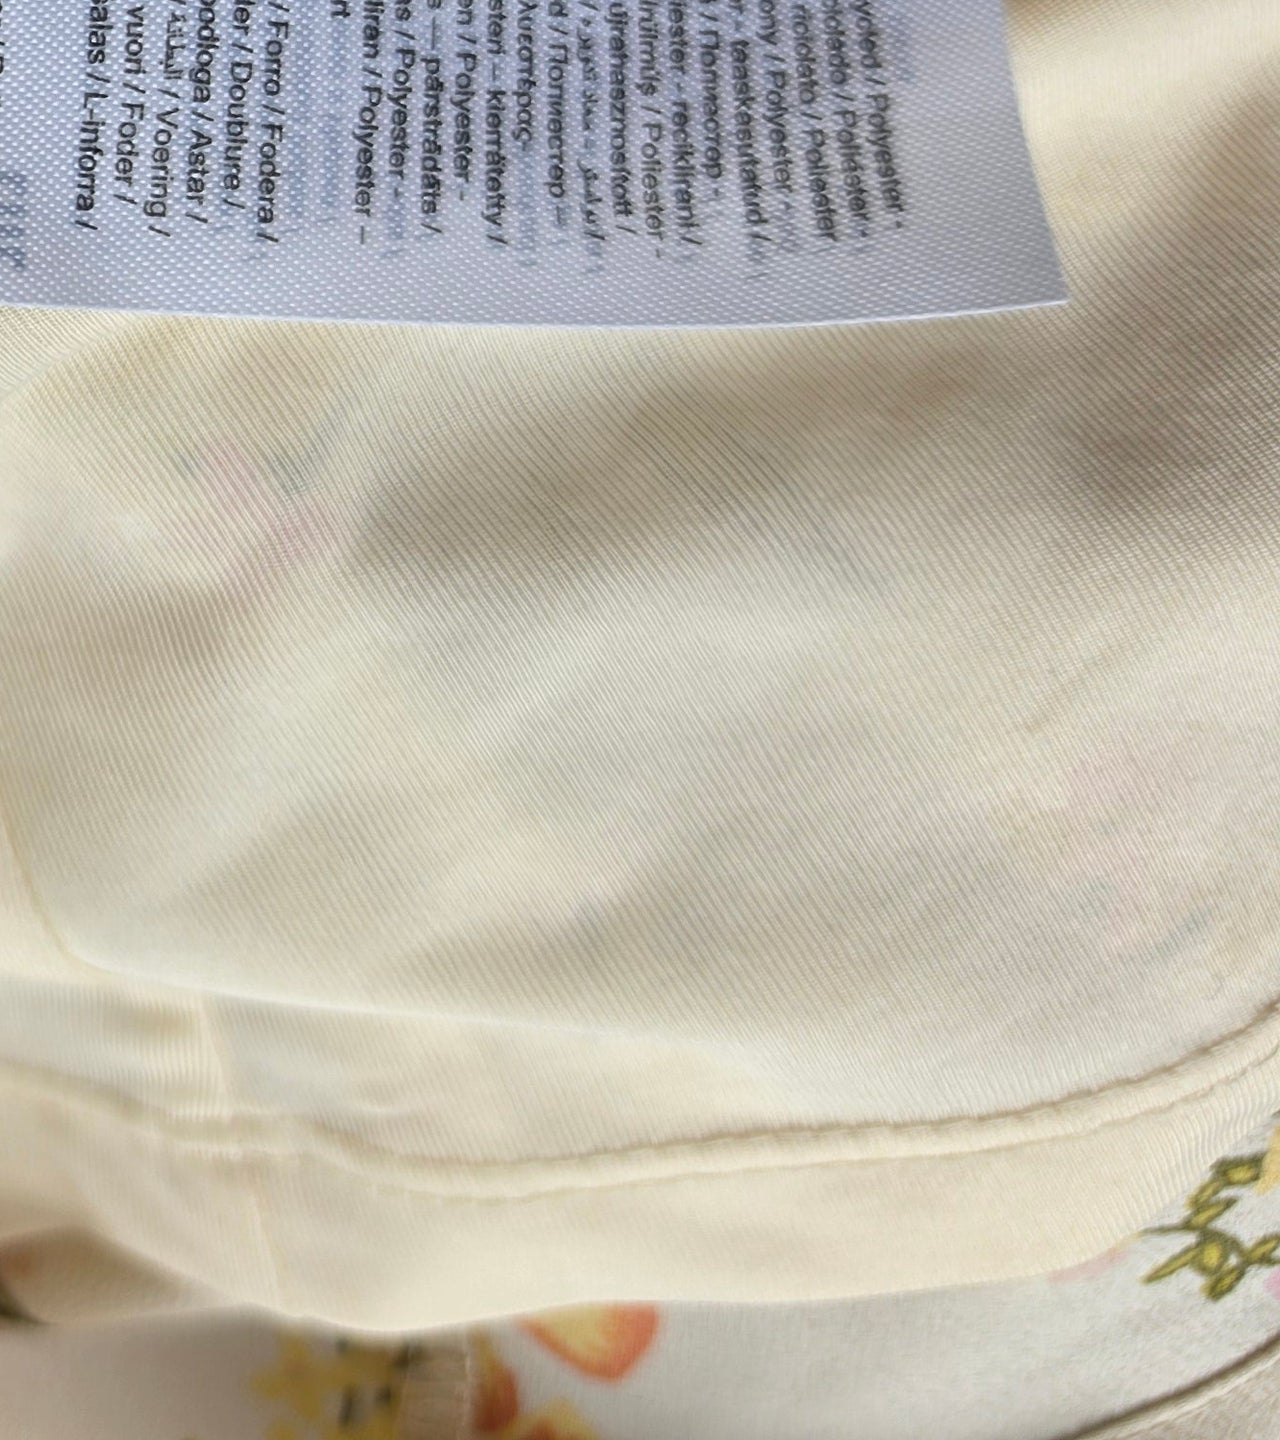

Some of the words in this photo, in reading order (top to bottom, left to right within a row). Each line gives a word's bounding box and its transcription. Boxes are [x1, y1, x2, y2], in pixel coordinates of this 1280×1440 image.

[264, 20, 288, 96] Forro
[383, 47, 414, 180] Polyester
[114, 101, 140, 186] Foder
[144, 106, 177, 217] Voering
[186, 129, 210, 204] Astar
[224, 61, 251, 190] Doublure
[348, 85, 380, 216] Polyester
[448, 51, 476, 181] Polyester
[257, 122, 282, 224] Fodera
